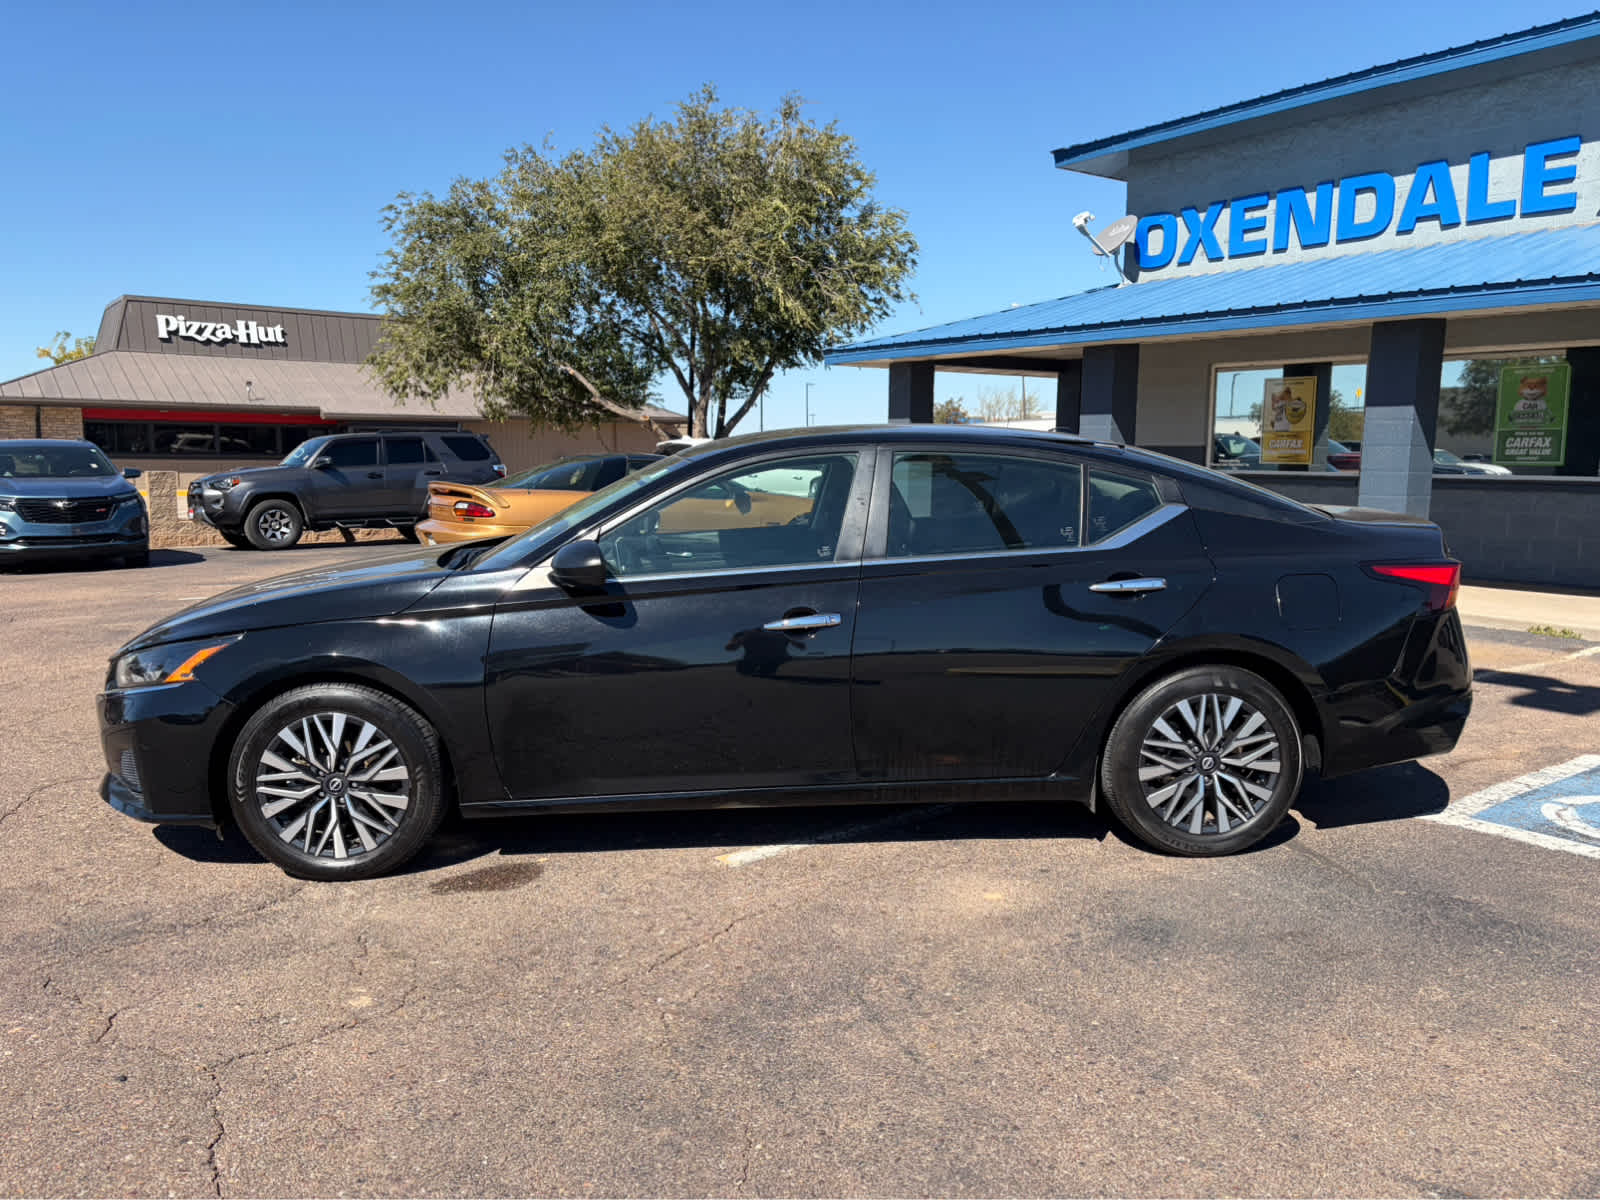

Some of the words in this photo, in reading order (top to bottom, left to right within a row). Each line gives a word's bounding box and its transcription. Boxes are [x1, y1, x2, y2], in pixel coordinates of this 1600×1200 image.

[1134, 136, 1581, 270] OXENDALE
[156, 314, 233, 342] Pizza
[1268, 439, 1304, 449] CARFAX
[1505, 437, 1552, 448] CARFAX
